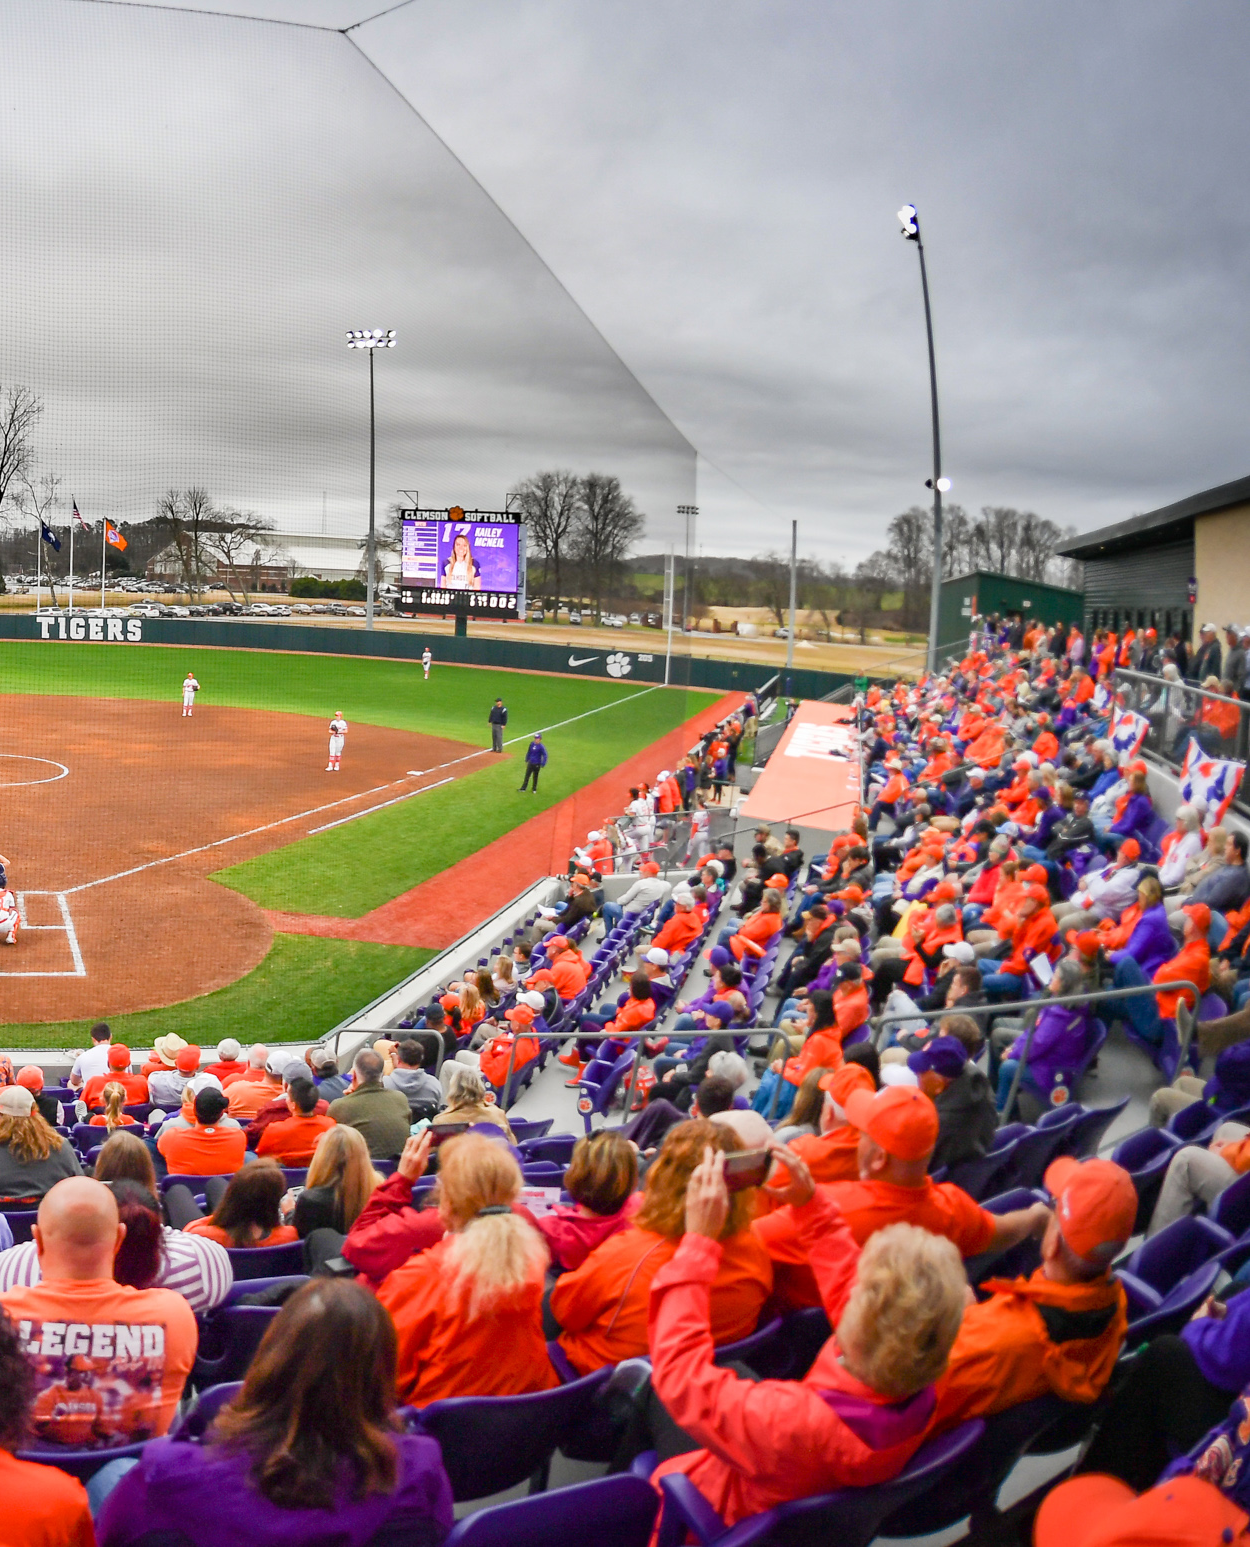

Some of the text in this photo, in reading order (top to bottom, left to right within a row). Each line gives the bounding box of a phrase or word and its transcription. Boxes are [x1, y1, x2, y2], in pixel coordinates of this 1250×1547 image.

[404, 511, 516, 523] CLEMSON SOFTBALL
[441, 523, 472, 543] 17
[474, 527, 503, 537] KAILEY
[474, 537, 505, 548] MCNEIL
[36, 616, 142, 641] TIGERS
[19, 1320, 165, 1358] LEGEND
